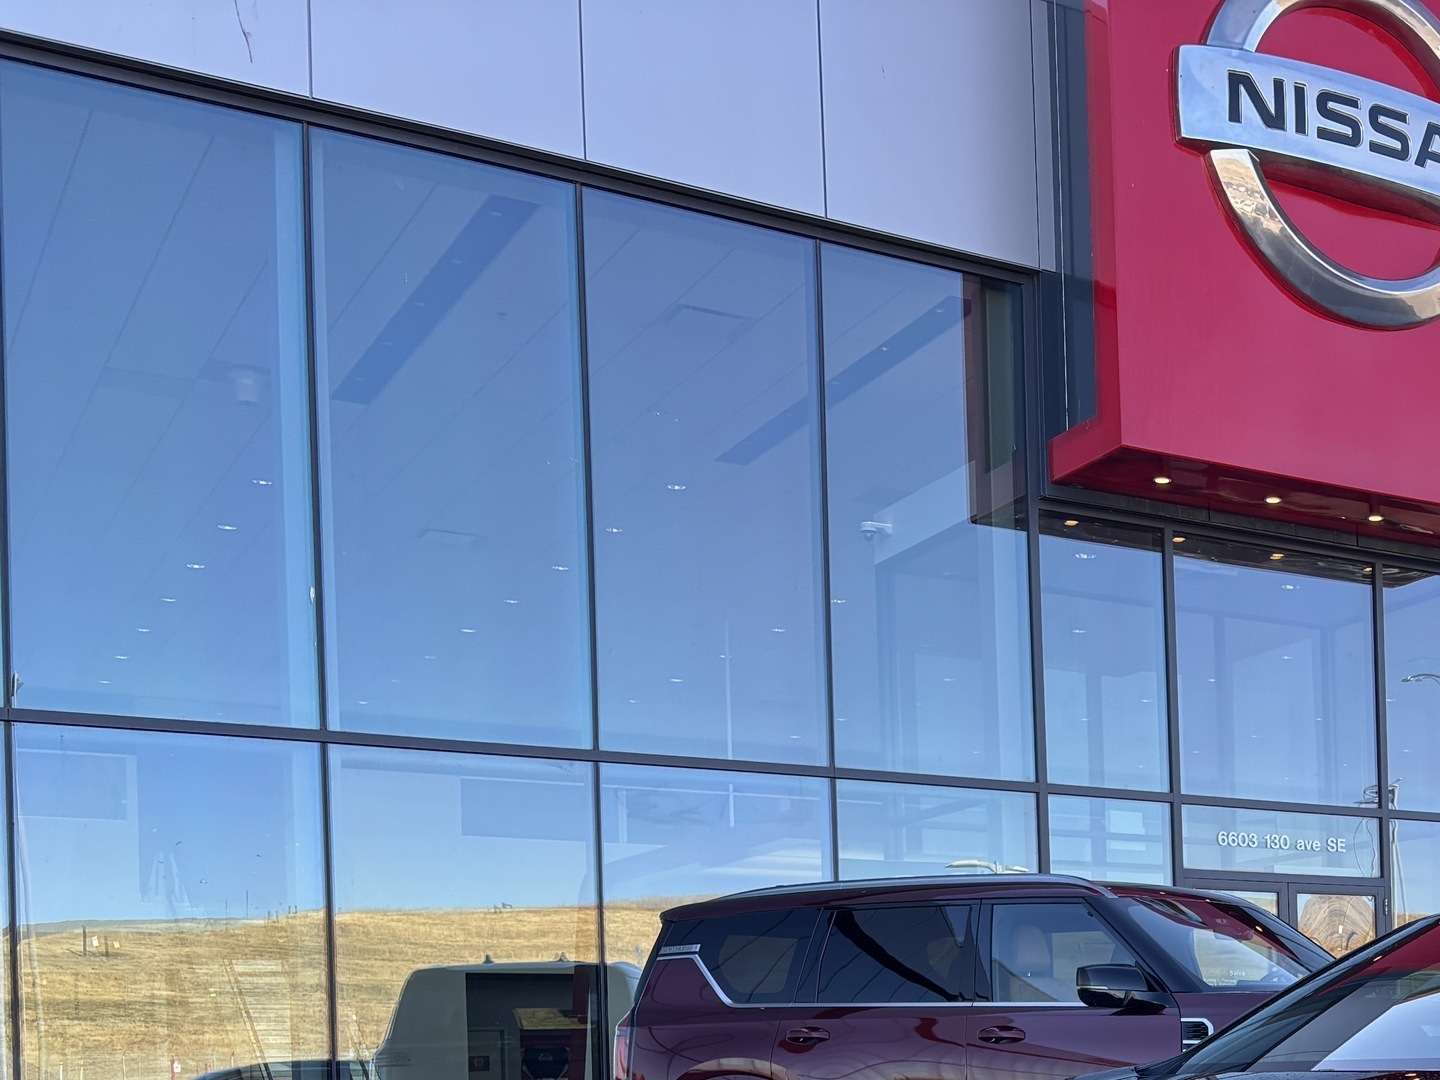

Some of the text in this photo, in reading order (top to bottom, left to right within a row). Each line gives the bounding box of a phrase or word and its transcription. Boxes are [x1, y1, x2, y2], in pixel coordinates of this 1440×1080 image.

[1217, 831, 1347, 853] 6603 130 ave SE
